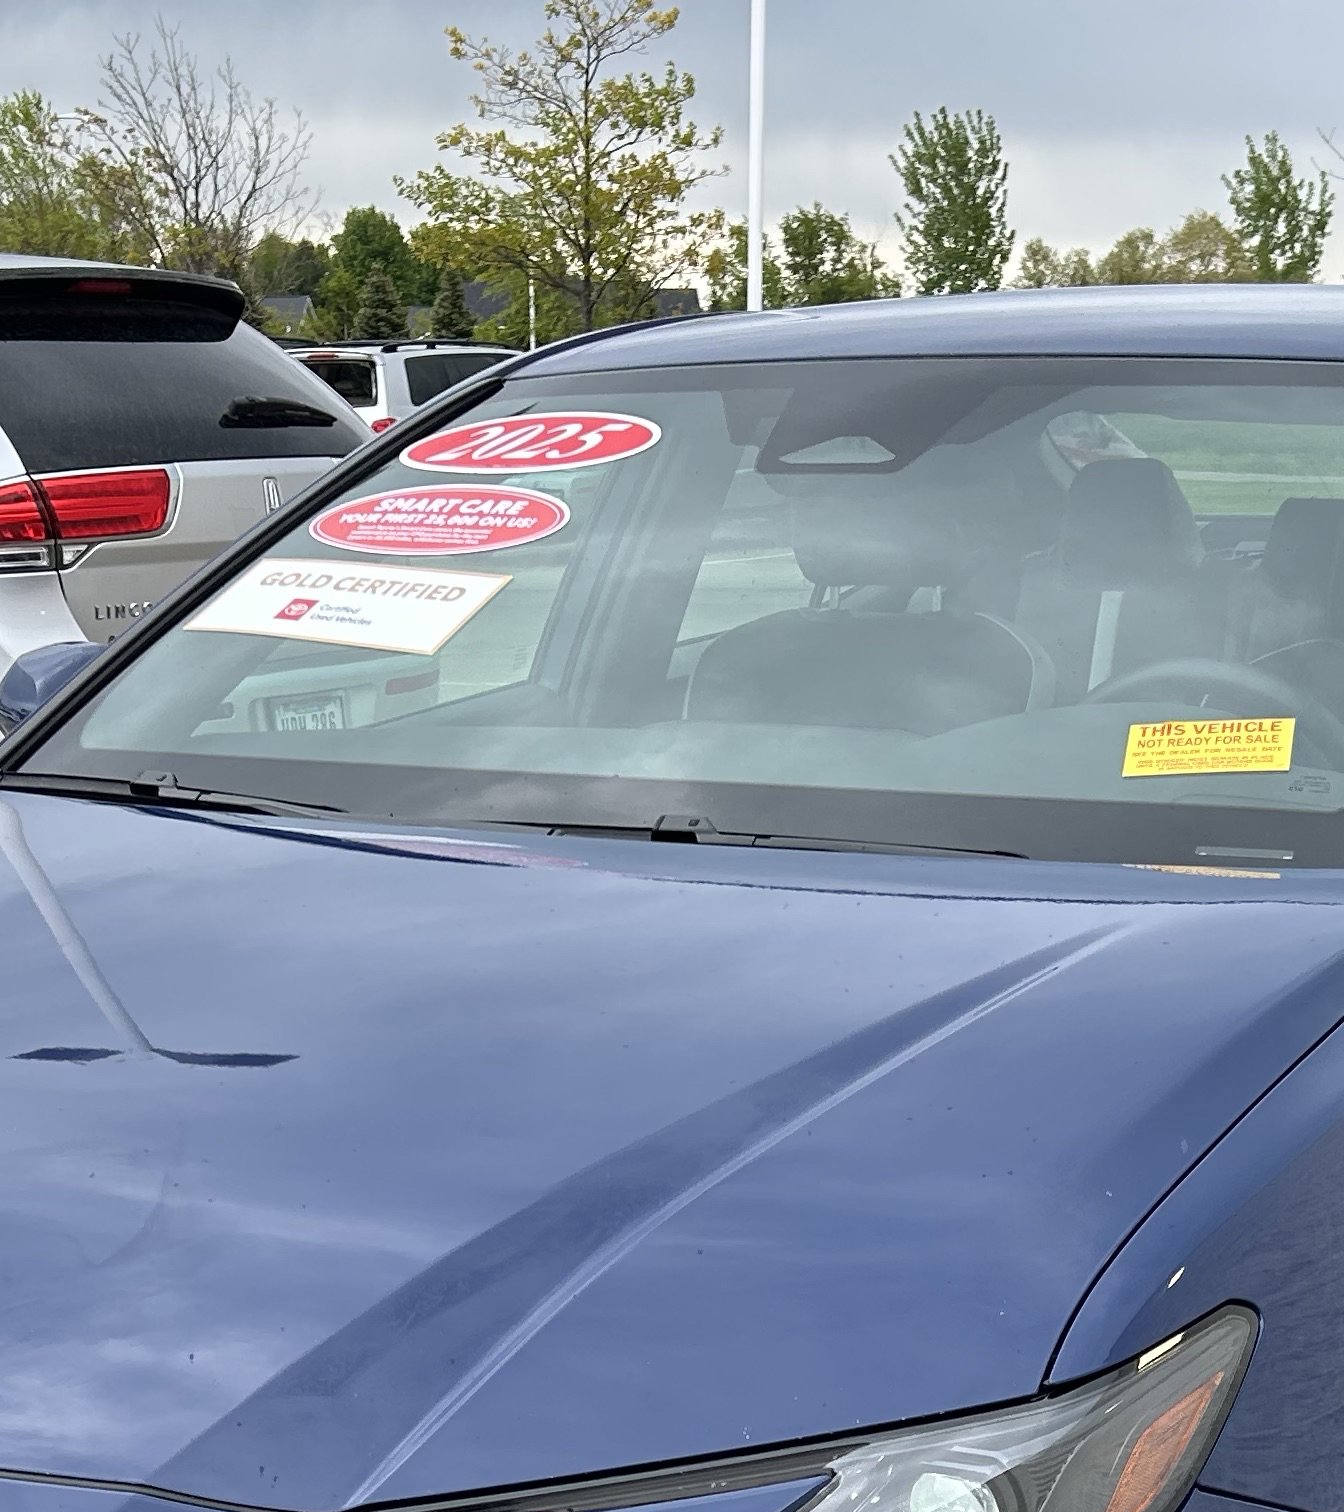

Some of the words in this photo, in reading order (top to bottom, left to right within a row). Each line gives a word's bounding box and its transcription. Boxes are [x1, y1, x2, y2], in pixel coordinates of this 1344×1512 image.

[424, 423, 633, 462] 2025
[374, 498, 460, 513] SMART
[459, 499, 528, 515] CARE
[339, 512, 379, 524] YOUR
[380, 513, 423, 525] FIRST
[477, 516, 504, 527] ON
[503, 517, 538, 529] US!
[260, 572, 333, 589] GOLD
[333, 576, 467, 602] CERTIFIED
[319, 603, 361, 615] Certified
[310, 613, 334, 622] Used
[336, 616, 372, 626] Vehicles
[1140, 723, 1186, 738] THIS
[1194, 721, 1283, 735] VEHICLE
[1138, 739, 1163, 749] NOT
[1167, 737, 1211, 747] READY
[1215, 736, 1241, 745] FOR
[1246, 734, 1280, 744] SALE
